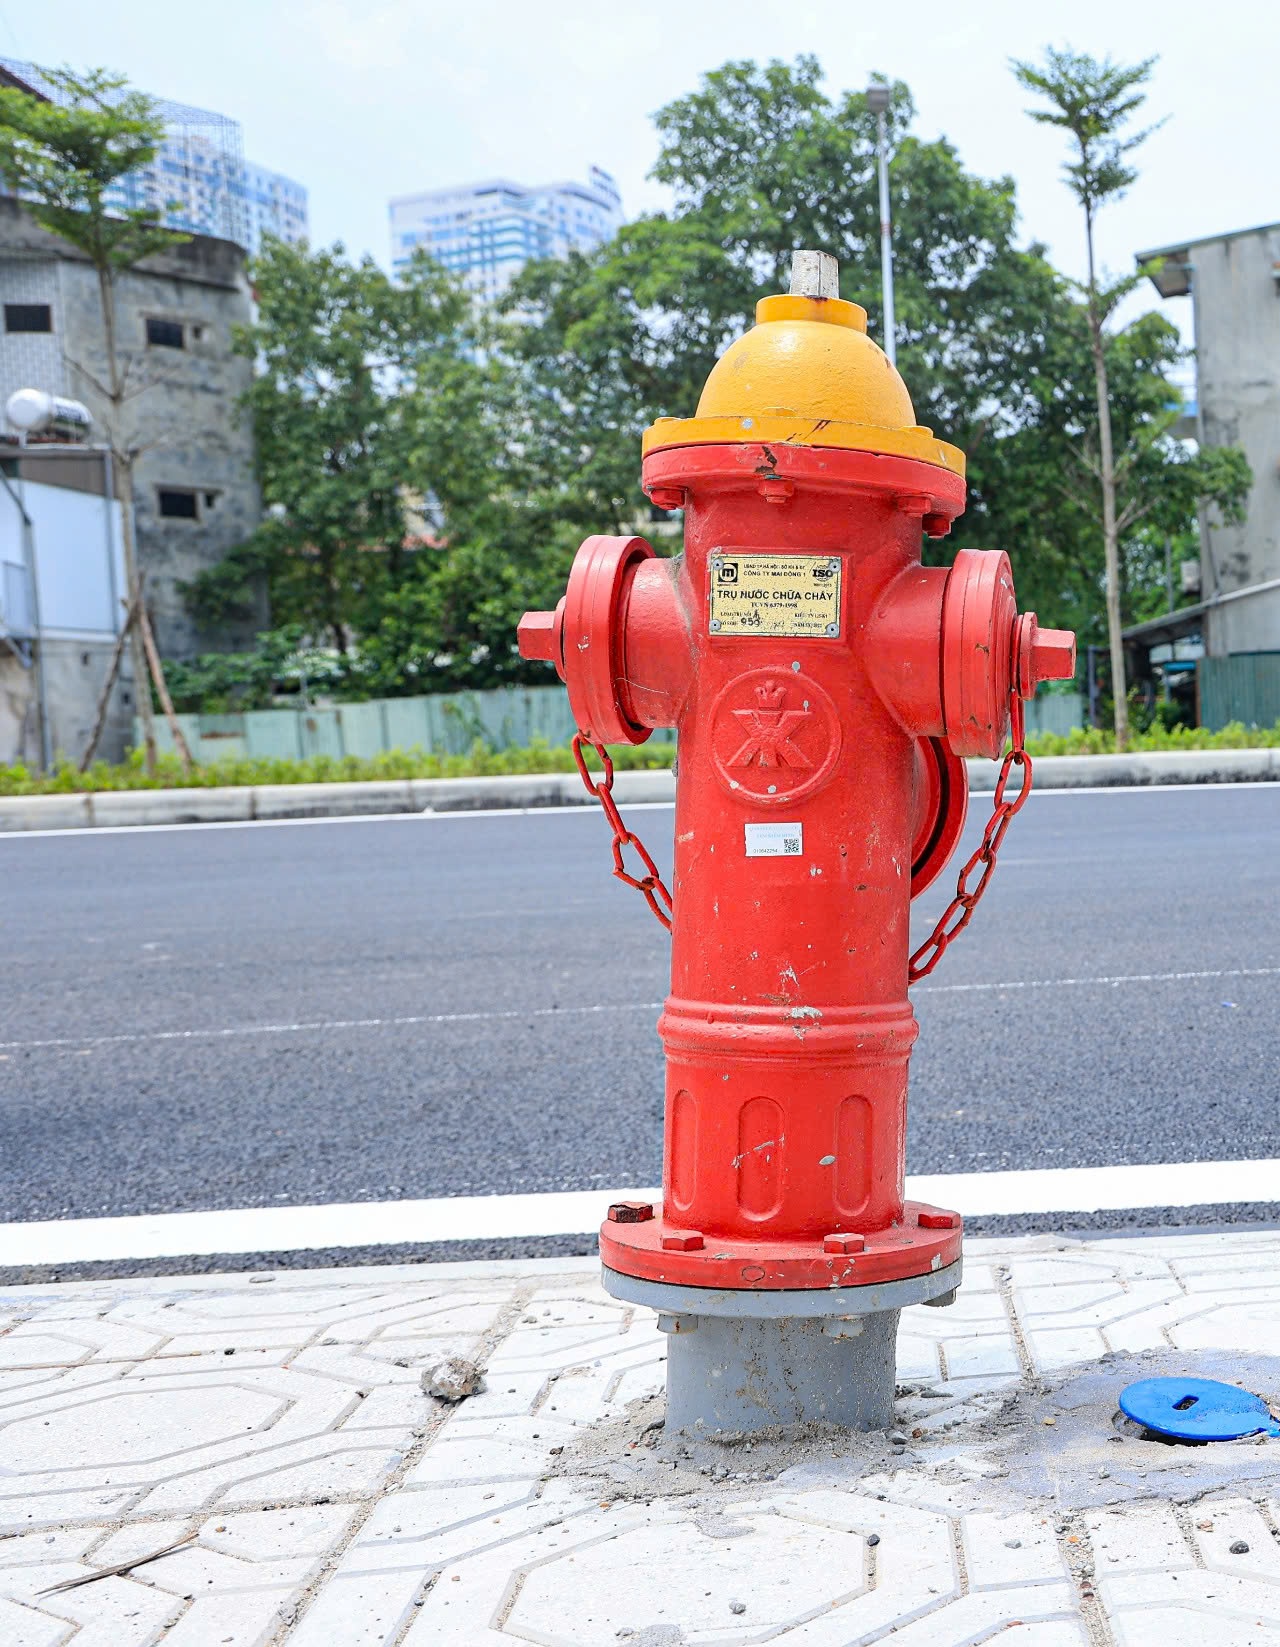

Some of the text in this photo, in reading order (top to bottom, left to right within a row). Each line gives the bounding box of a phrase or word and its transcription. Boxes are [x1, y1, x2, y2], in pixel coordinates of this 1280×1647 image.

[812, 568, 834, 577] ISO
[717, 589, 833, 601] TRỤ NƯỚC CHỮA CHÁY
